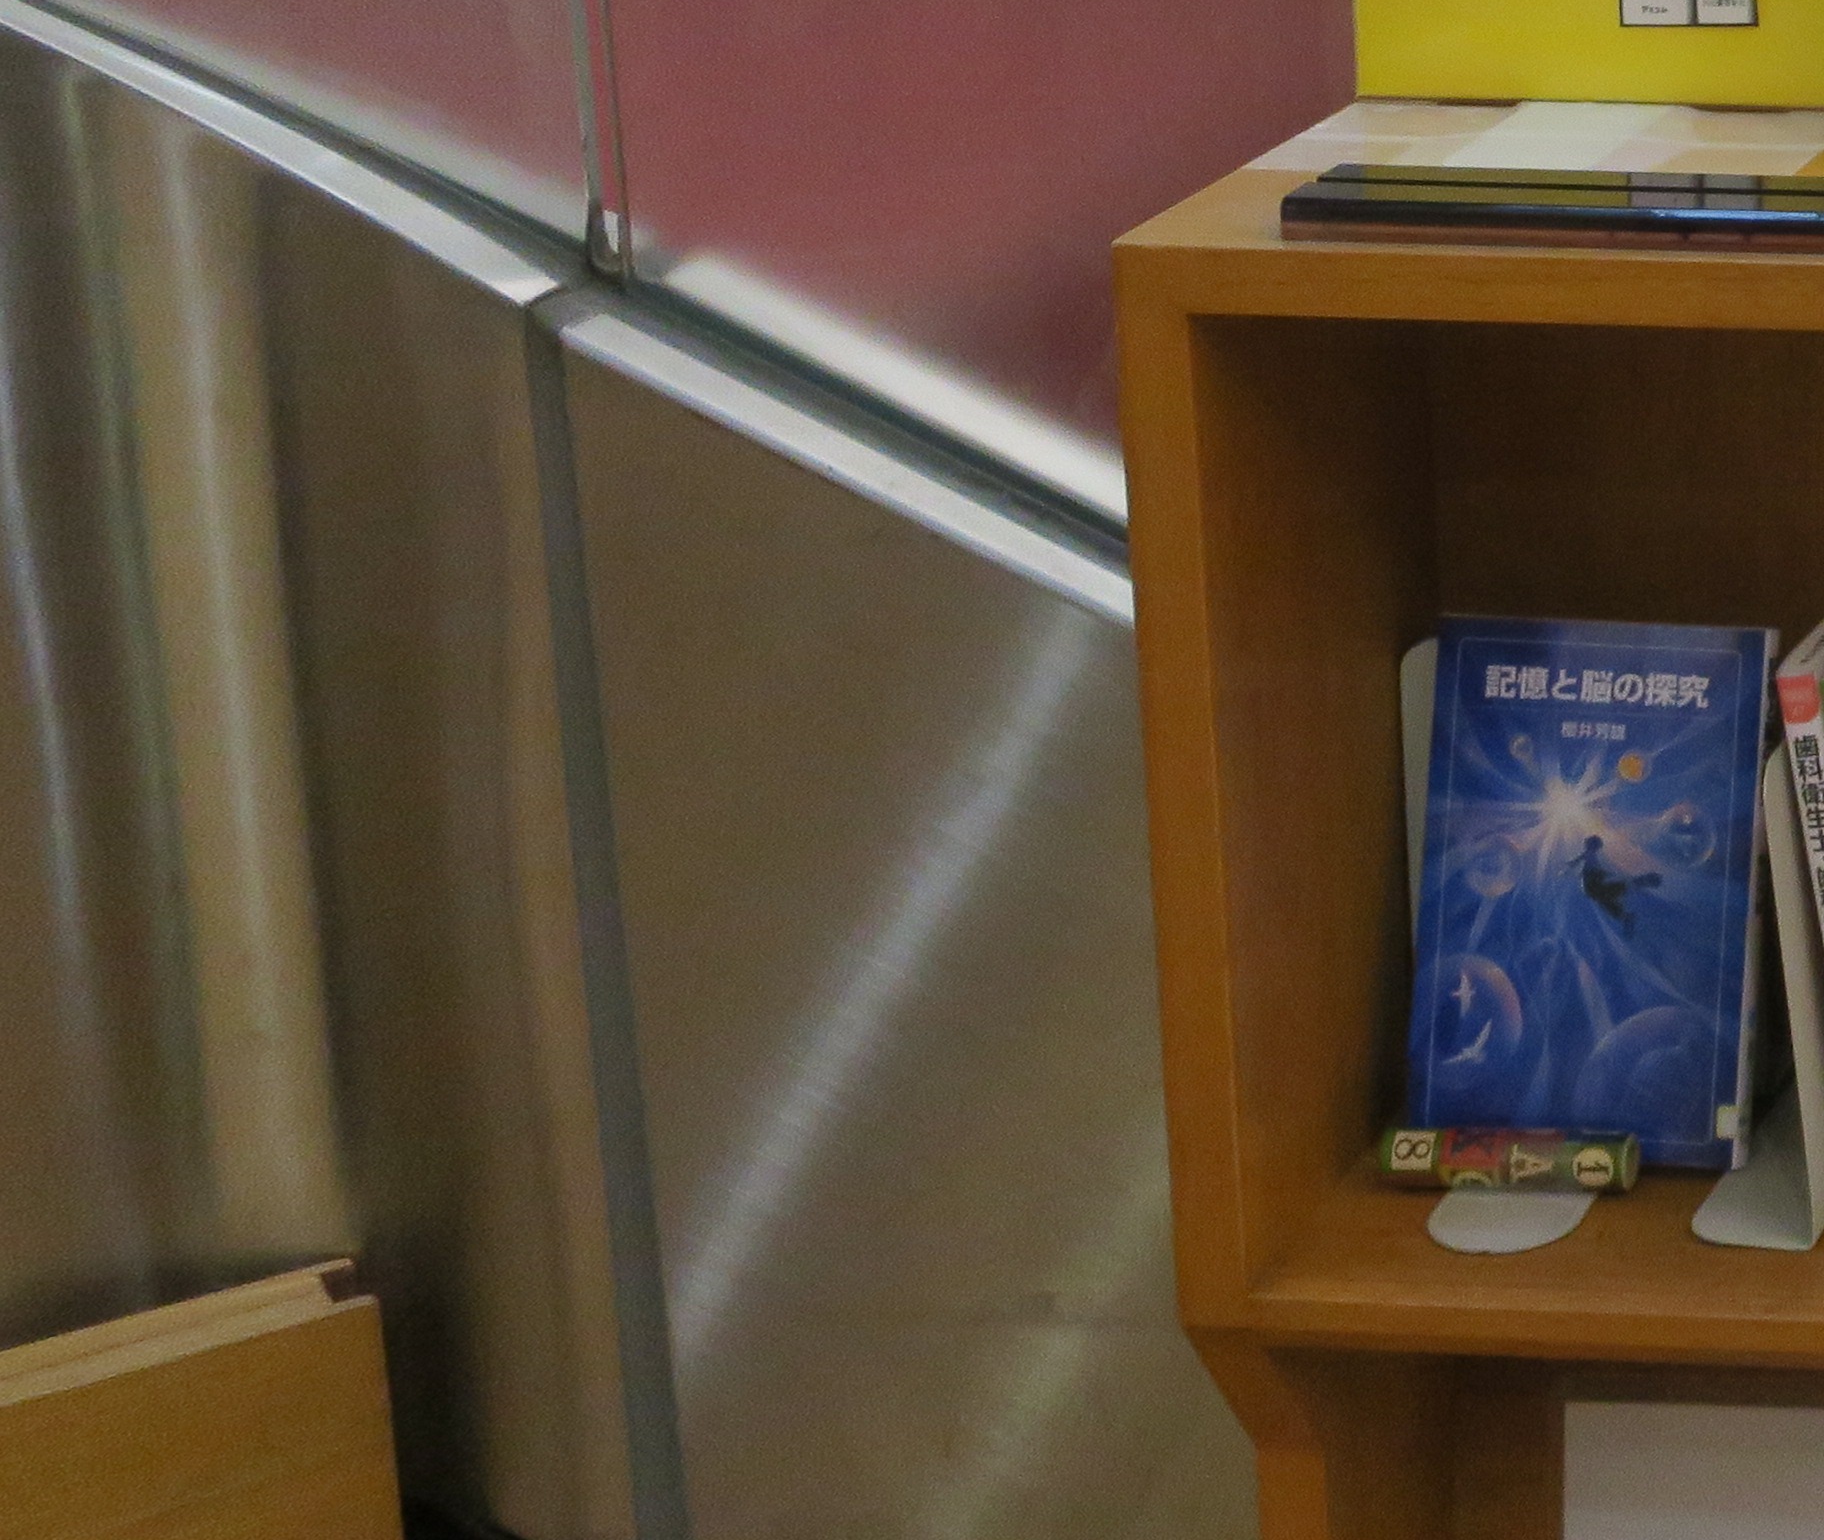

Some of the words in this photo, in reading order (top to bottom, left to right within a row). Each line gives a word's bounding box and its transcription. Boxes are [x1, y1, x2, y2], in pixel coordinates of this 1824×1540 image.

[1485, 664, 1710, 708] 記憶と脳の探究
